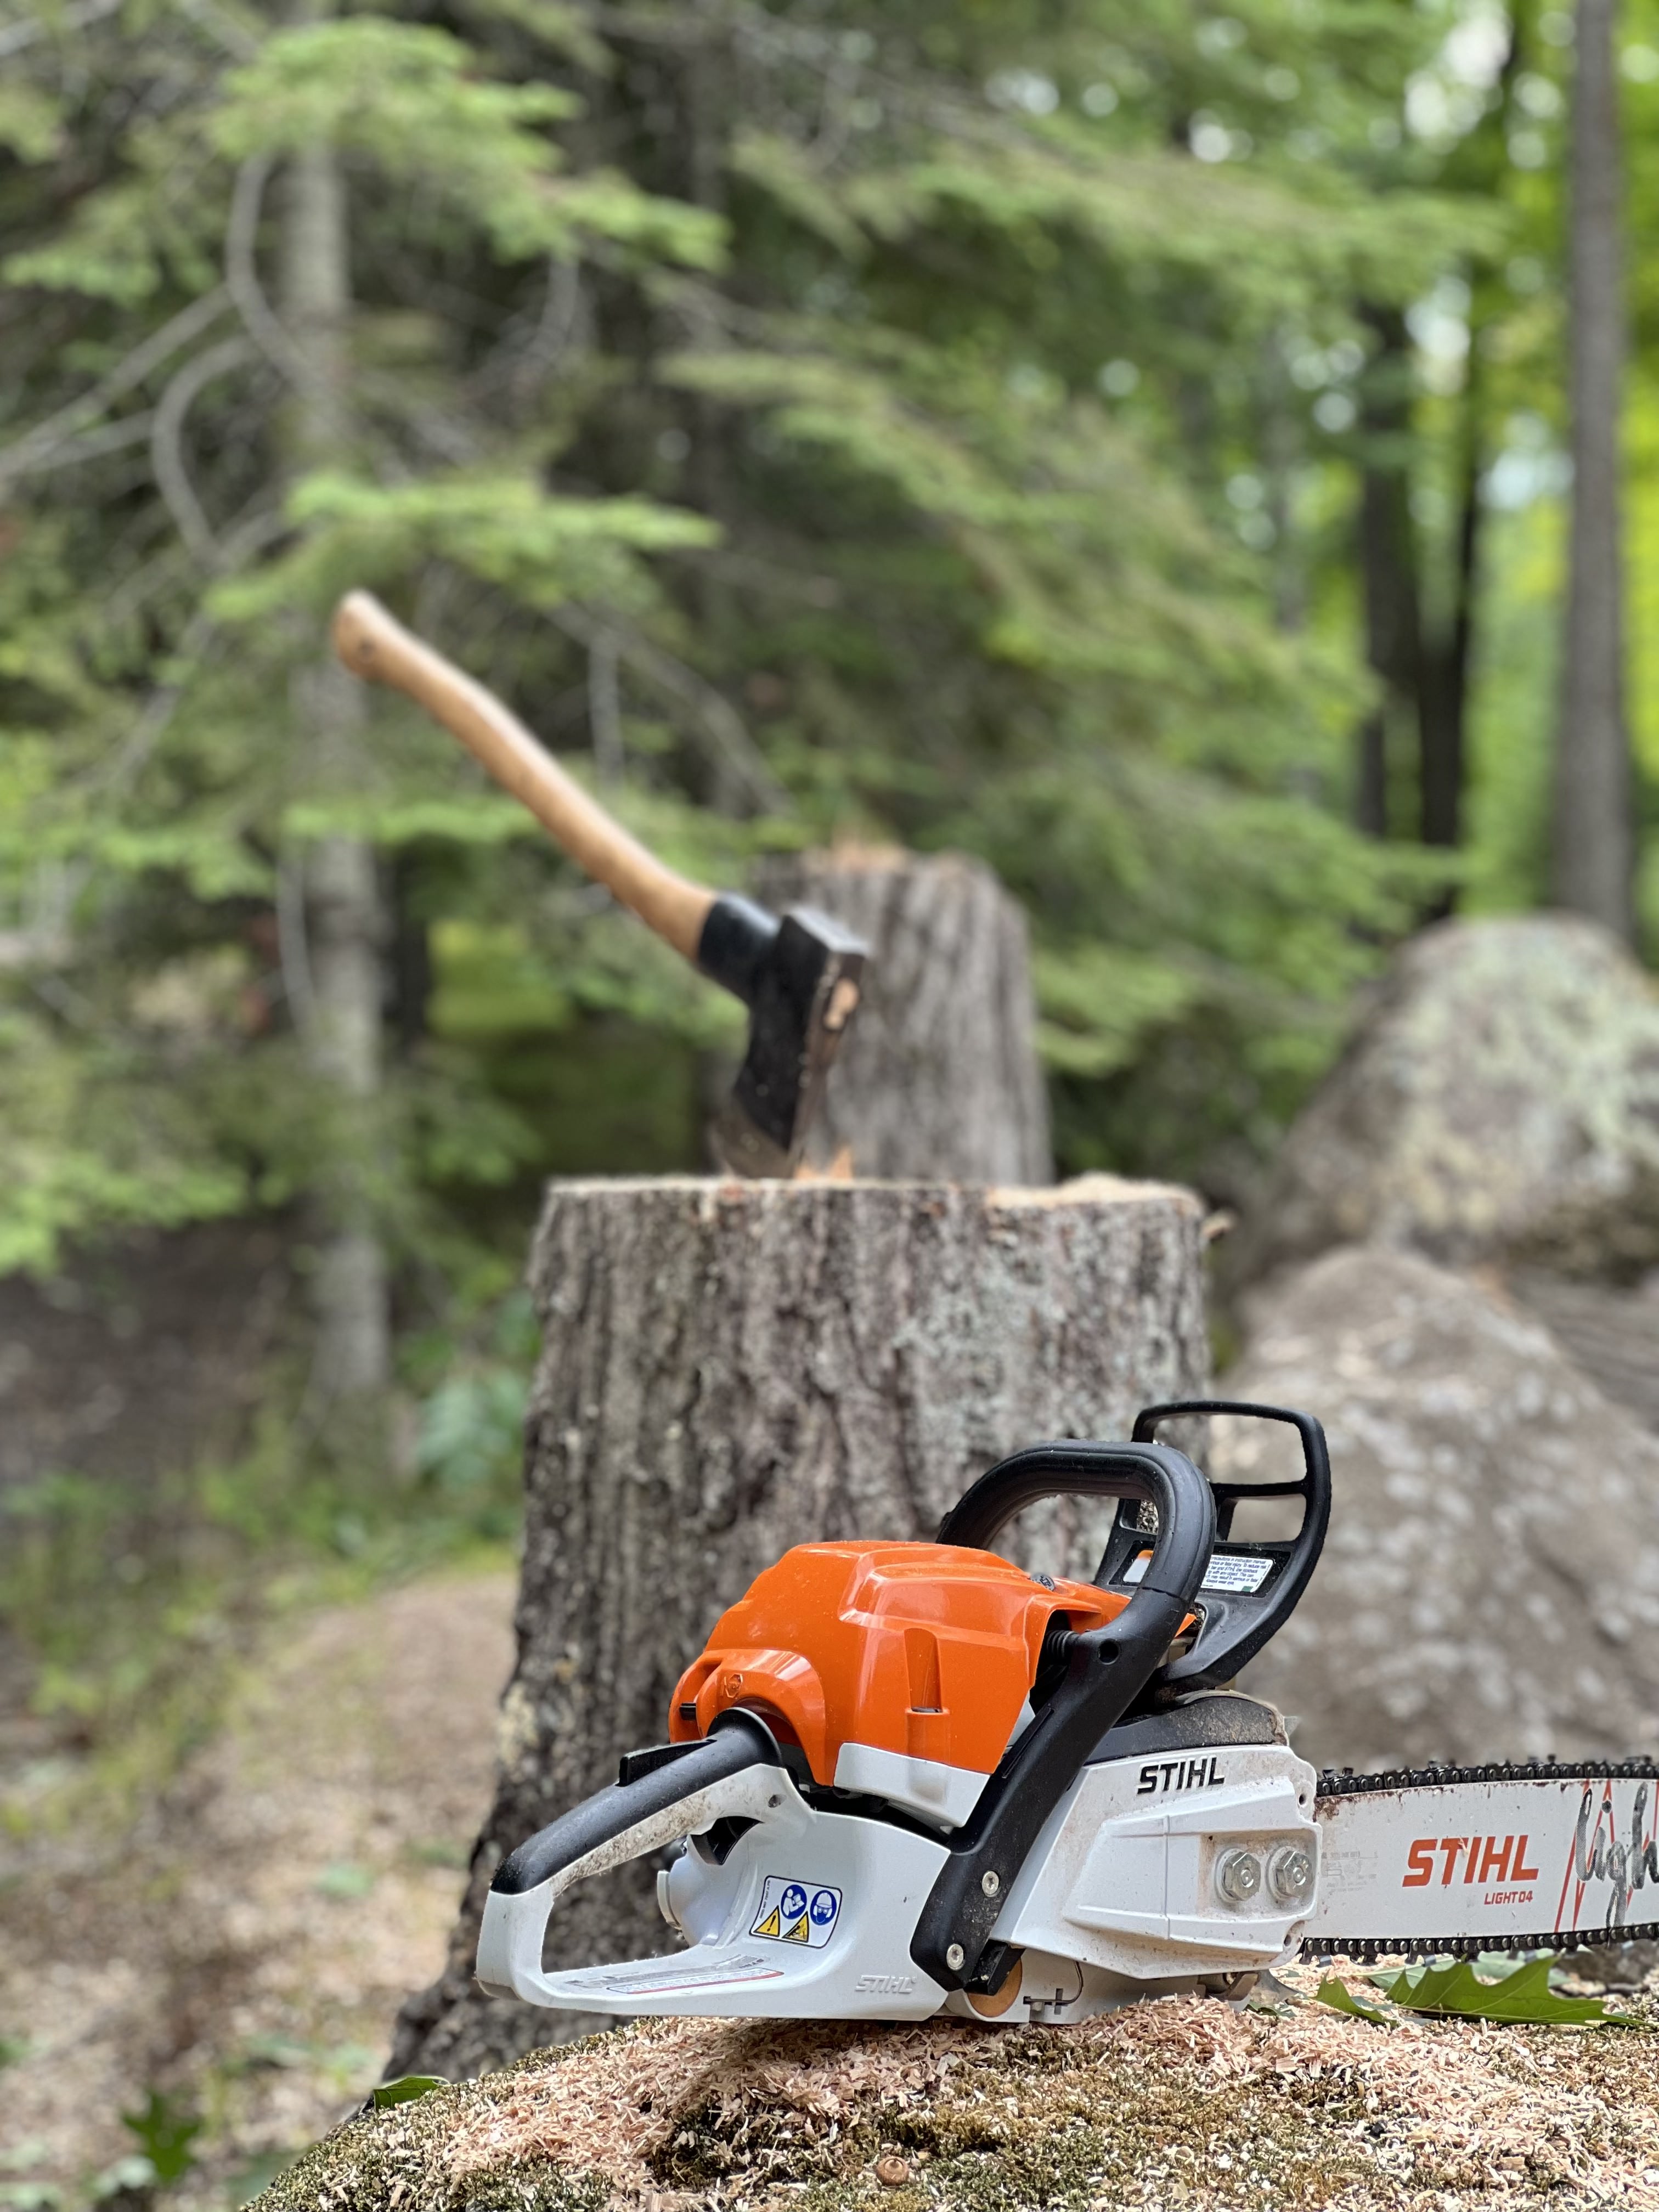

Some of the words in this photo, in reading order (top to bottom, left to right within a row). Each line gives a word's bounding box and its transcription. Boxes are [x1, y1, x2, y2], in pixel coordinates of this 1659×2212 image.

[1137, 1756, 1225, 1795] STIHL
[1402, 1835, 1539, 1887] STIHL
[855, 1975, 912, 1994] STIHL
